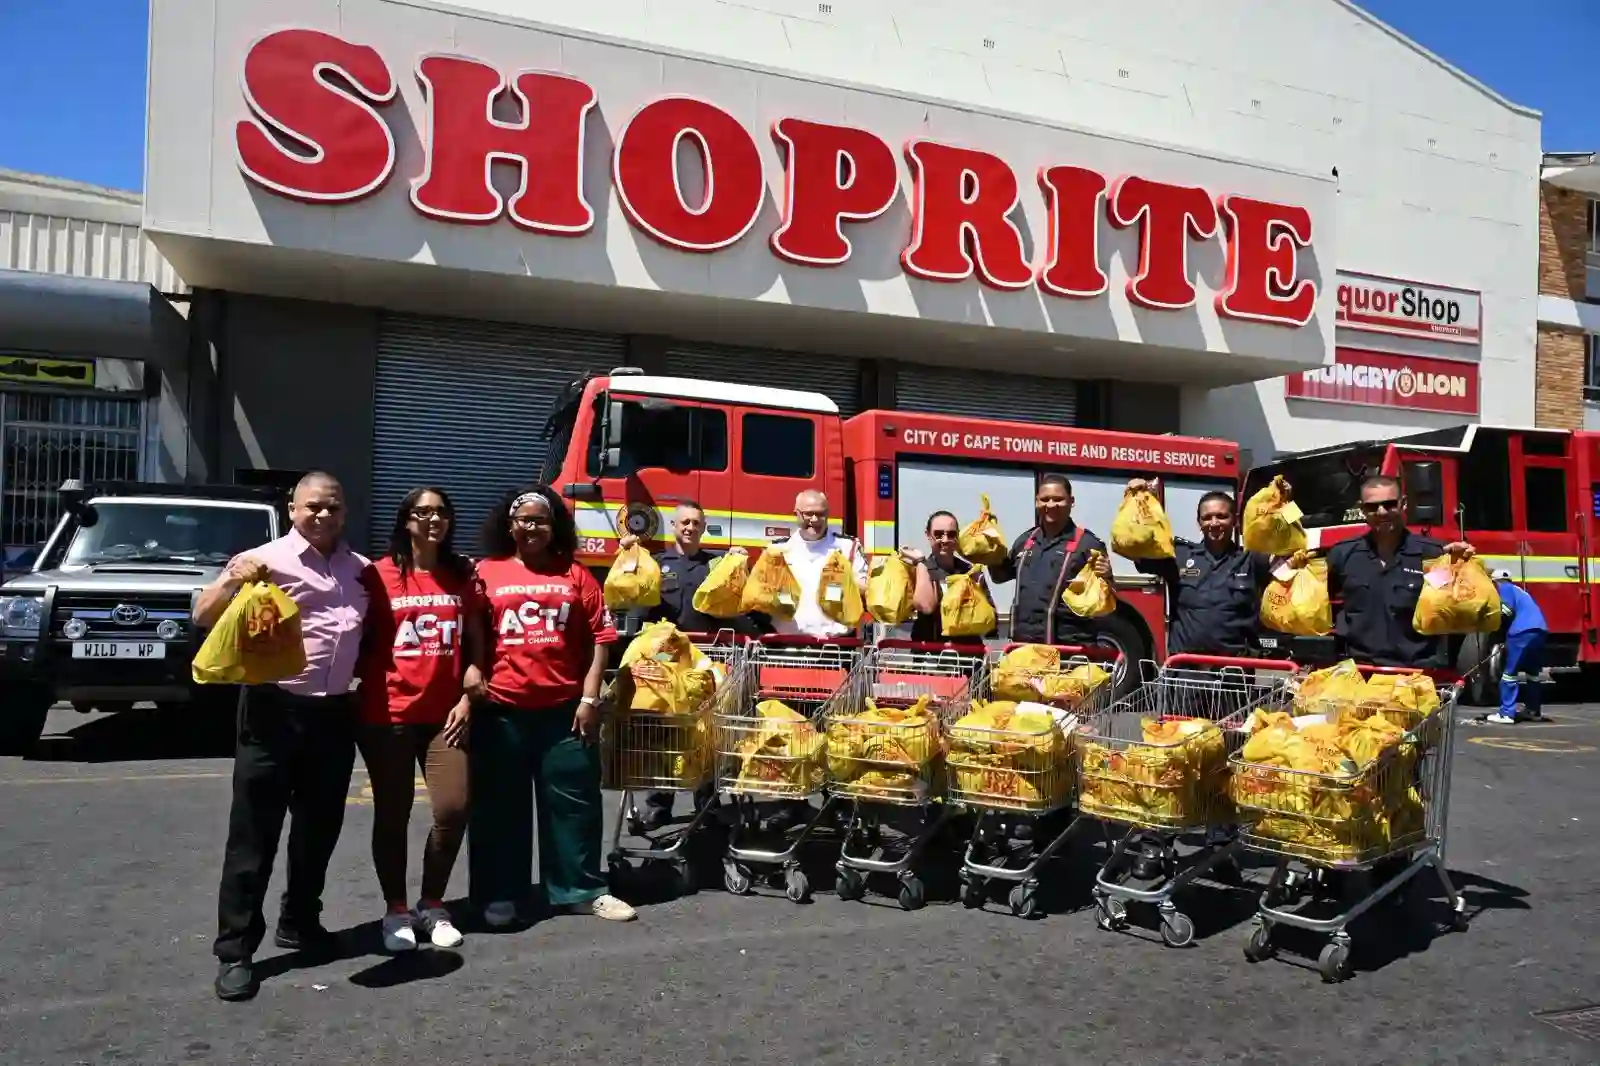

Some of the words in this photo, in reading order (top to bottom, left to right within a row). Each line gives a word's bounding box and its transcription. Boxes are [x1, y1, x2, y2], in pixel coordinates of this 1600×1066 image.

[235, 27, 1318, 327] SHOPRITE
[1416, 371, 1467, 397] LION
[903, 429, 938, 446] CITY
[941, 433, 960, 448] OF
[963, 434, 1001, 450] CAPE
[1003, 437, 1043, 453] TOWN
[1047, 441, 1077, 457] FIRE
[1080, 444, 1107, 460] AND
[1111, 446, 1161, 464] RESCUE
[1163, 451, 1216, 468] SERVICE
[499, 601, 571, 632] ACT!
[84, 643, 118, 657] WILD
[138, 643, 154, 657] WP
